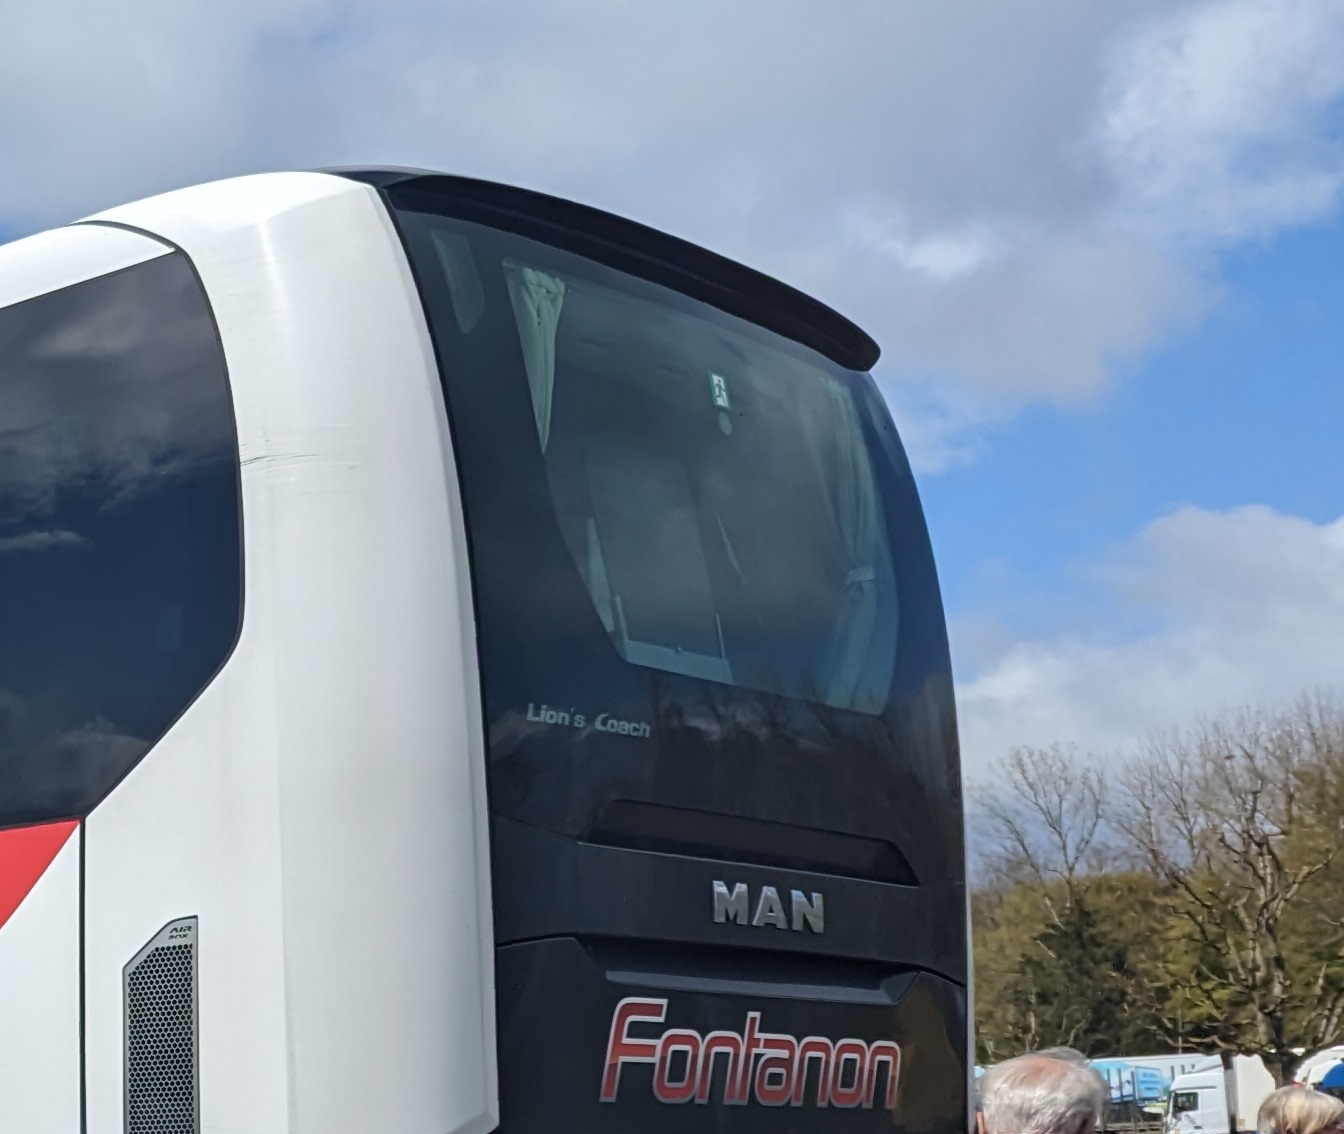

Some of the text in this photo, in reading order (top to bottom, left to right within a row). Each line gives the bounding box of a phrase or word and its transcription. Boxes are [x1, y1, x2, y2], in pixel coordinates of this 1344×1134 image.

[526, 702, 651, 739] Lion's Coach
[712, 879, 825, 934] MAN
[599, 996, 901, 1110] Fontanon
